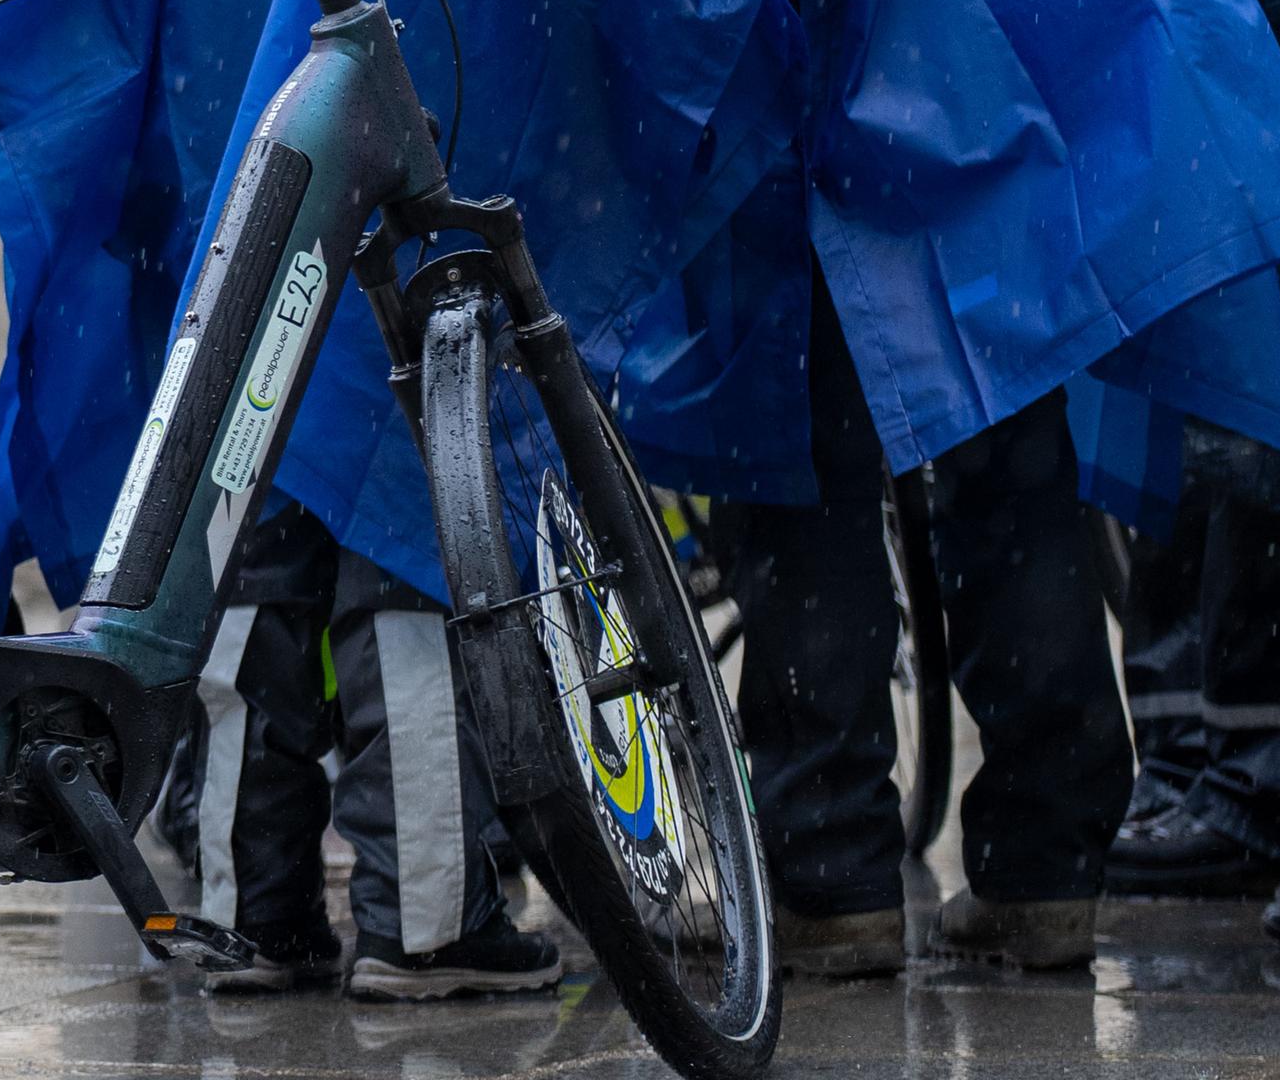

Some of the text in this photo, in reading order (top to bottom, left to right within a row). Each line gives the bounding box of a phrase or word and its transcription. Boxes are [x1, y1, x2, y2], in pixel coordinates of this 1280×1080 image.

[258, 80, 299, 137] macina
[257, 325, 291, 400] pedalpower
[243, 427, 252, 438] 72
[247, 417, 256, 428] 34
[215, 407, 248, 478] Bike Rental & Tours
[236, 417, 267, 489] www.pedalpower.at
[238, 437, 248, 451] 729
[230, 456, 241, 471] +43
